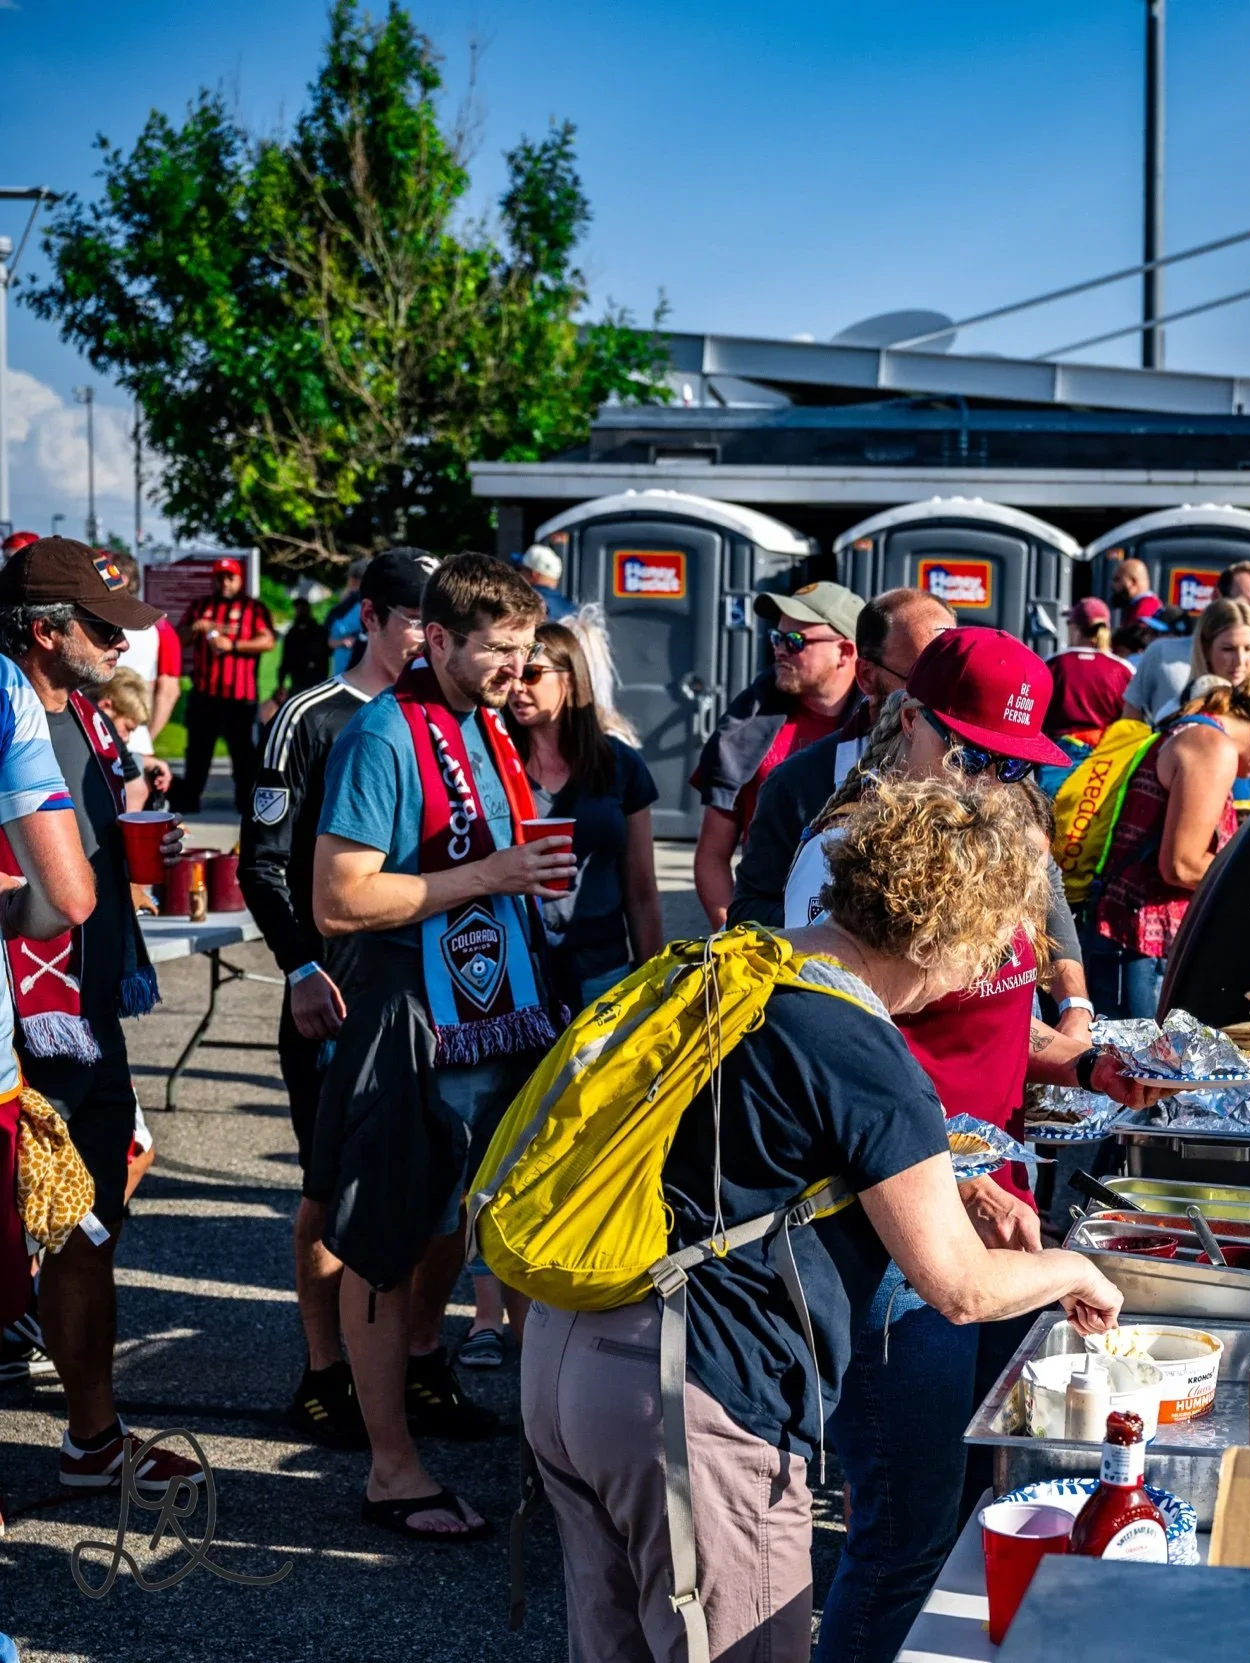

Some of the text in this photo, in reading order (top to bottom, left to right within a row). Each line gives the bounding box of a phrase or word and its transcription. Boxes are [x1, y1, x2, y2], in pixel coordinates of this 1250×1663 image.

[1020, 682, 1031, 697] BE
[1006, 693, 1035, 713] A GOOD
[450, 928, 499, 953] COLORADO
[1187, 1371, 1214, 1385] KRONOS
